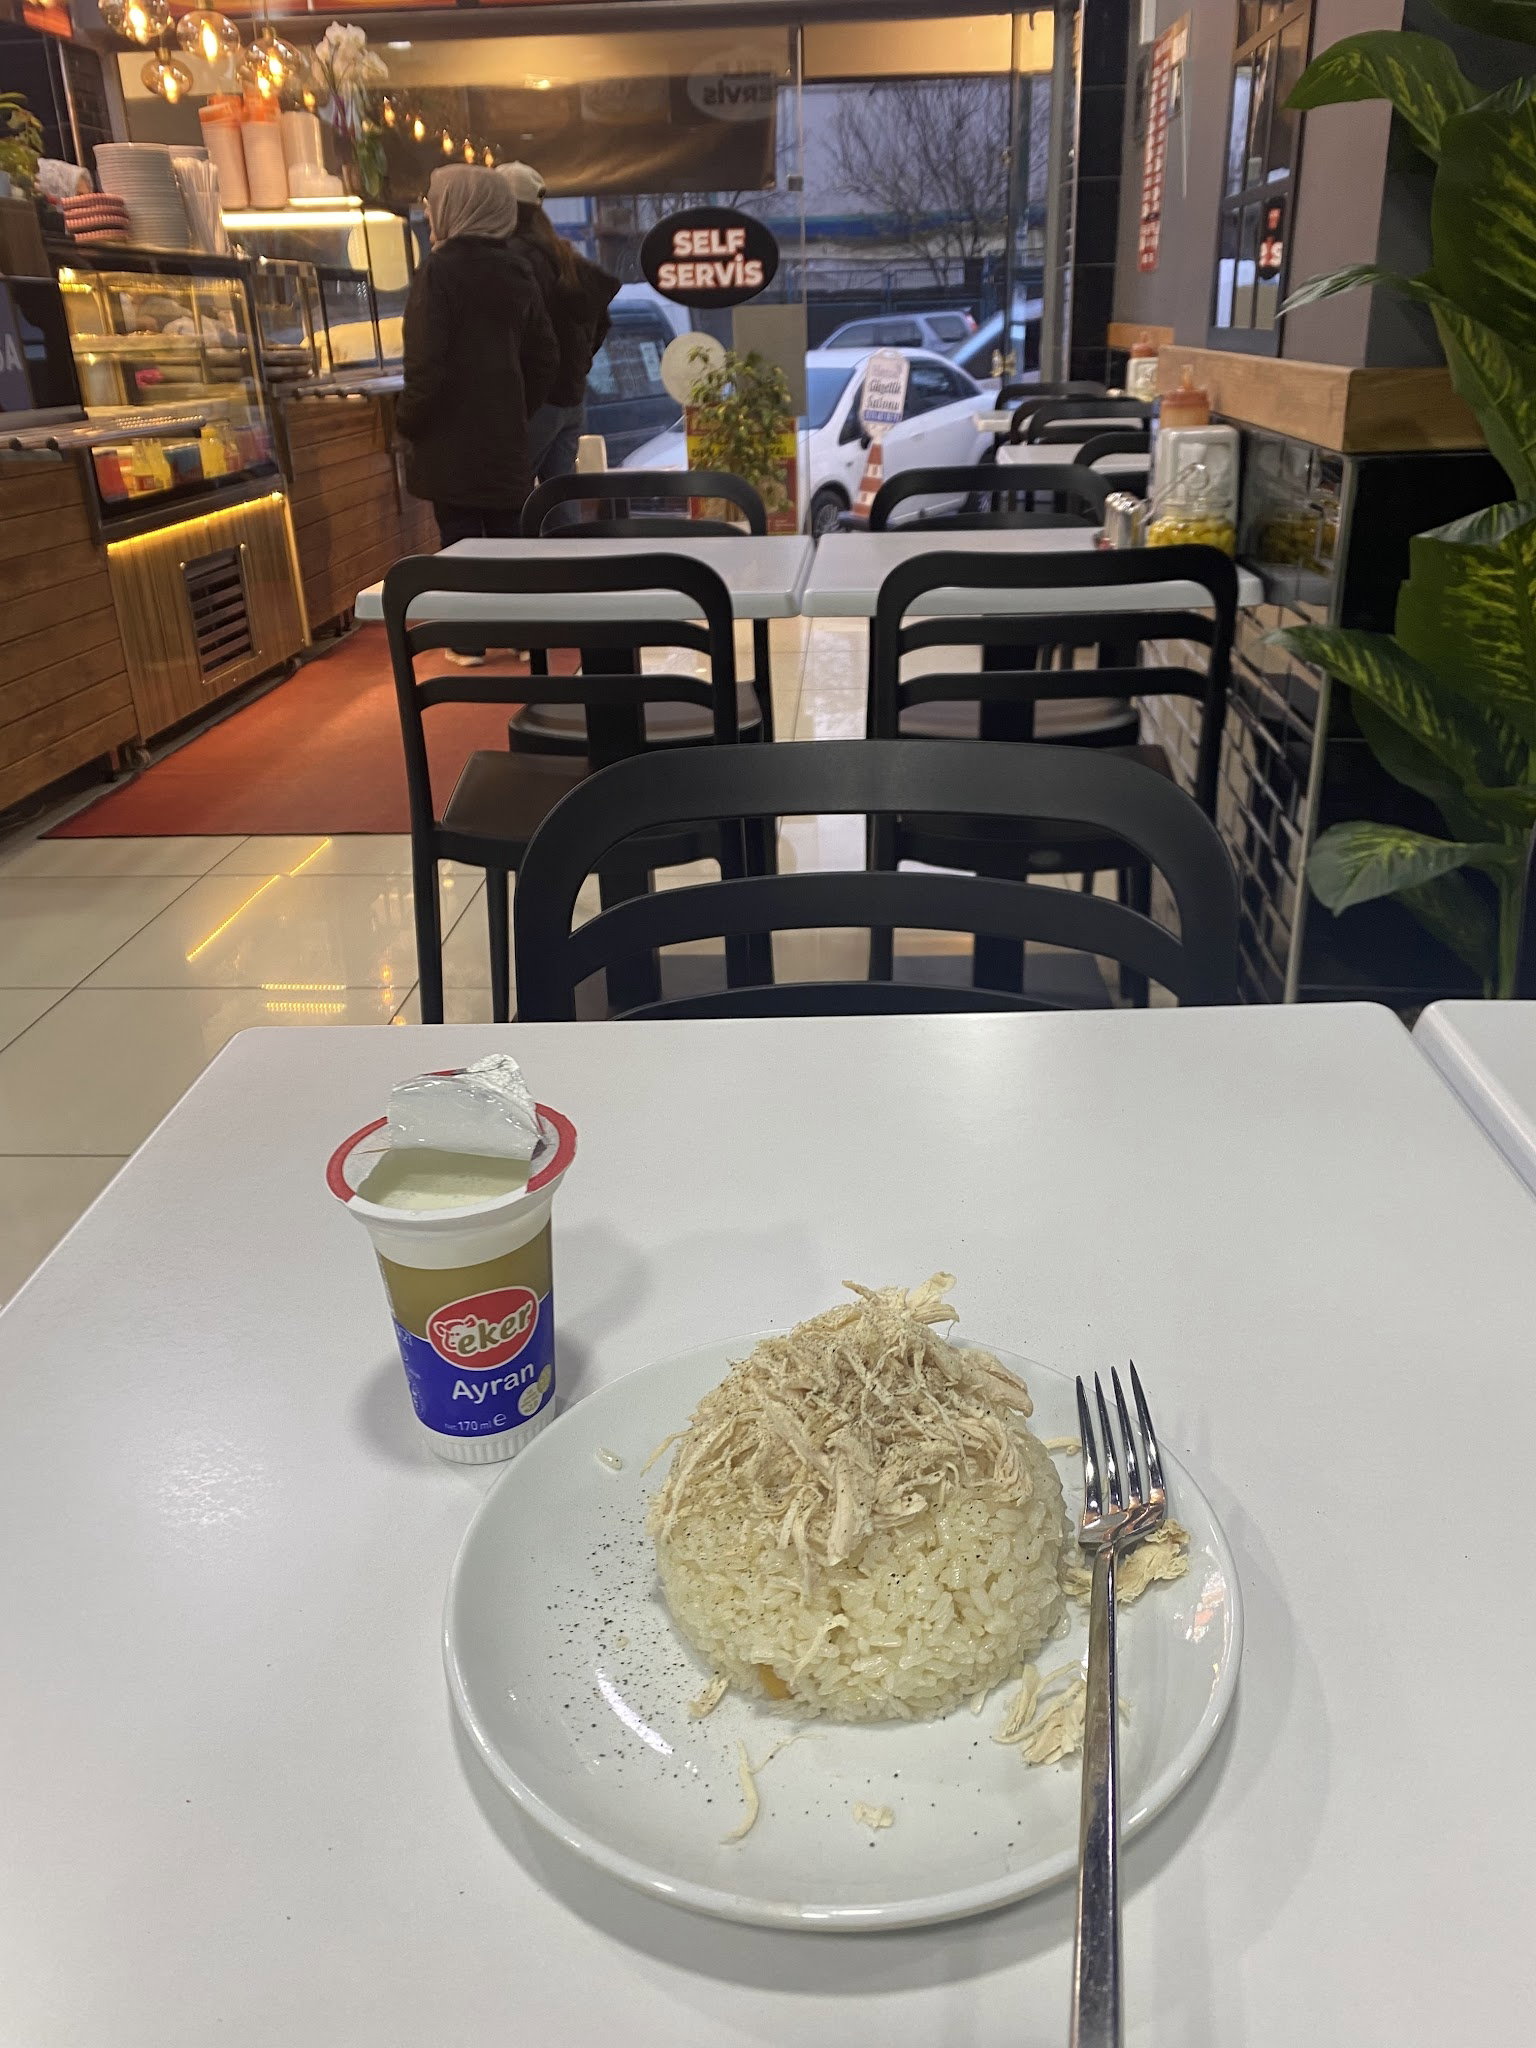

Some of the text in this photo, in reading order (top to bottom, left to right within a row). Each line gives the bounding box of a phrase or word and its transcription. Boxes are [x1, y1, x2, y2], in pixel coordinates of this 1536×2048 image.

[673, 227, 746, 257] SELF
[657, 252, 764, 289] SERVİS
[456, 1301, 533, 1356] eker
[452, 1363, 535, 1404] Ayran
[457, 1420, 478, 1431] 170
